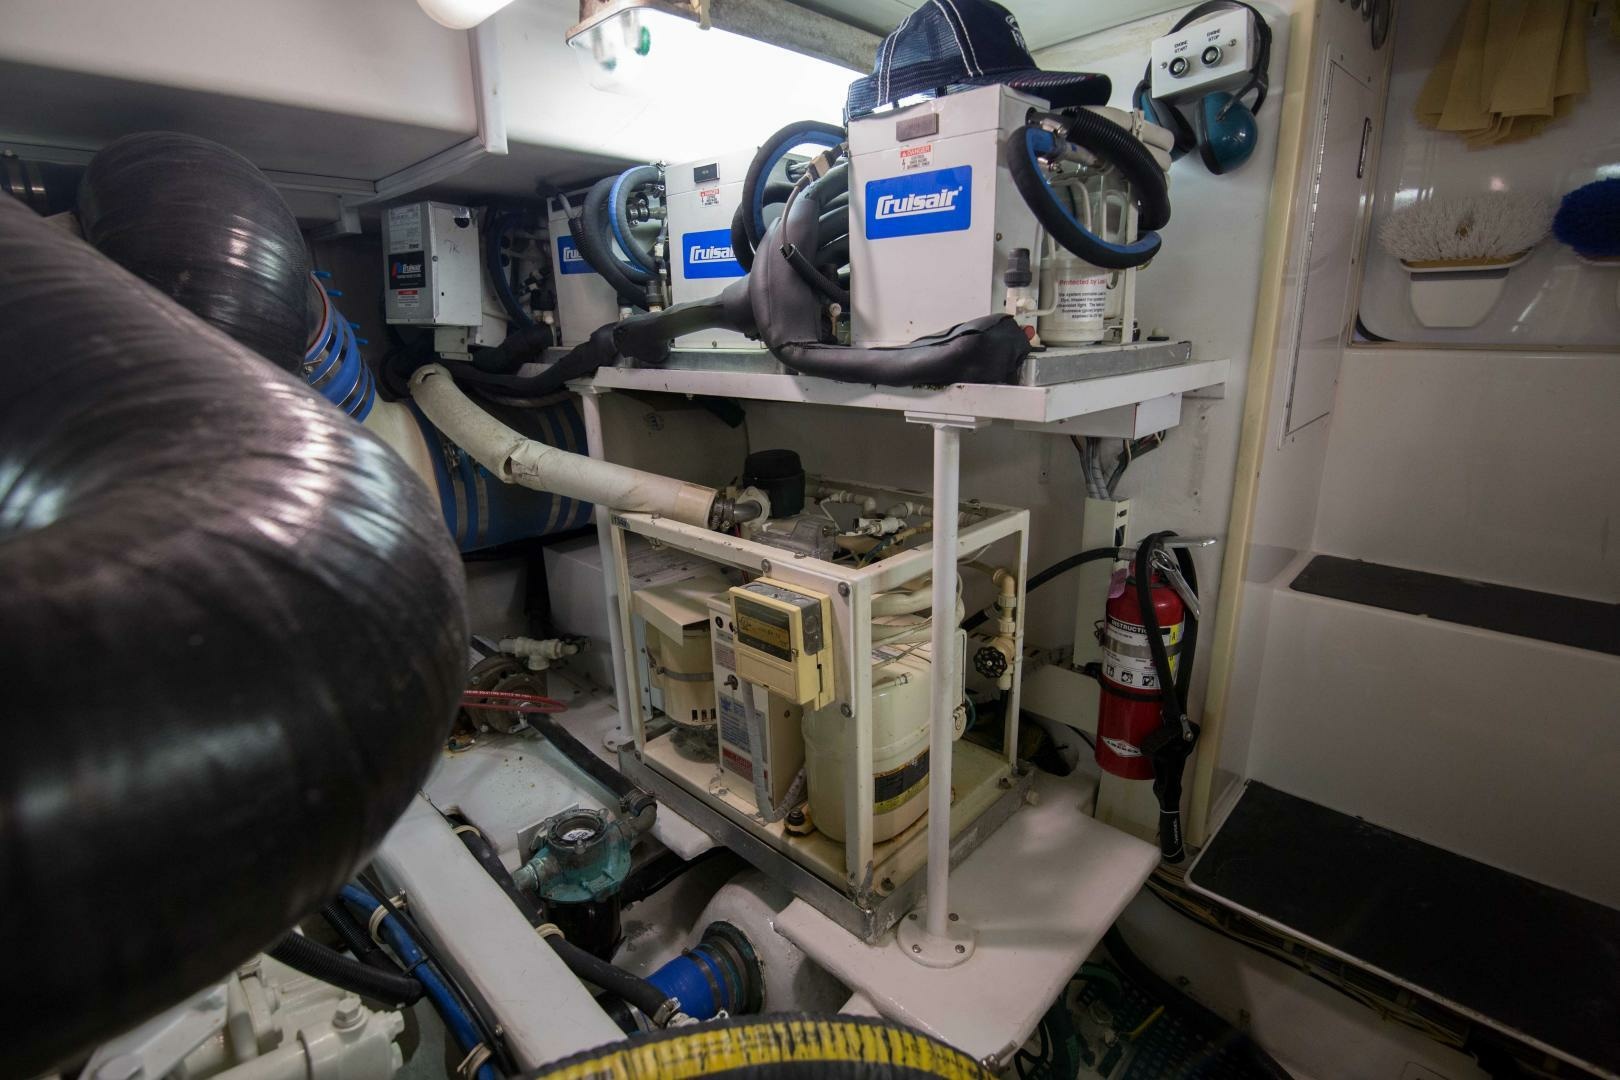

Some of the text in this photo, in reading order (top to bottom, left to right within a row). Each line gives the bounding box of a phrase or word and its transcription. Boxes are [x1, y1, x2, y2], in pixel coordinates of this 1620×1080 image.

[1208, 34, 1220, 42] STOP
[1174, 45, 1188, 53] START
[875, 188, 960, 220] Cruisair
[689, 245, 737, 263] Cruisai
